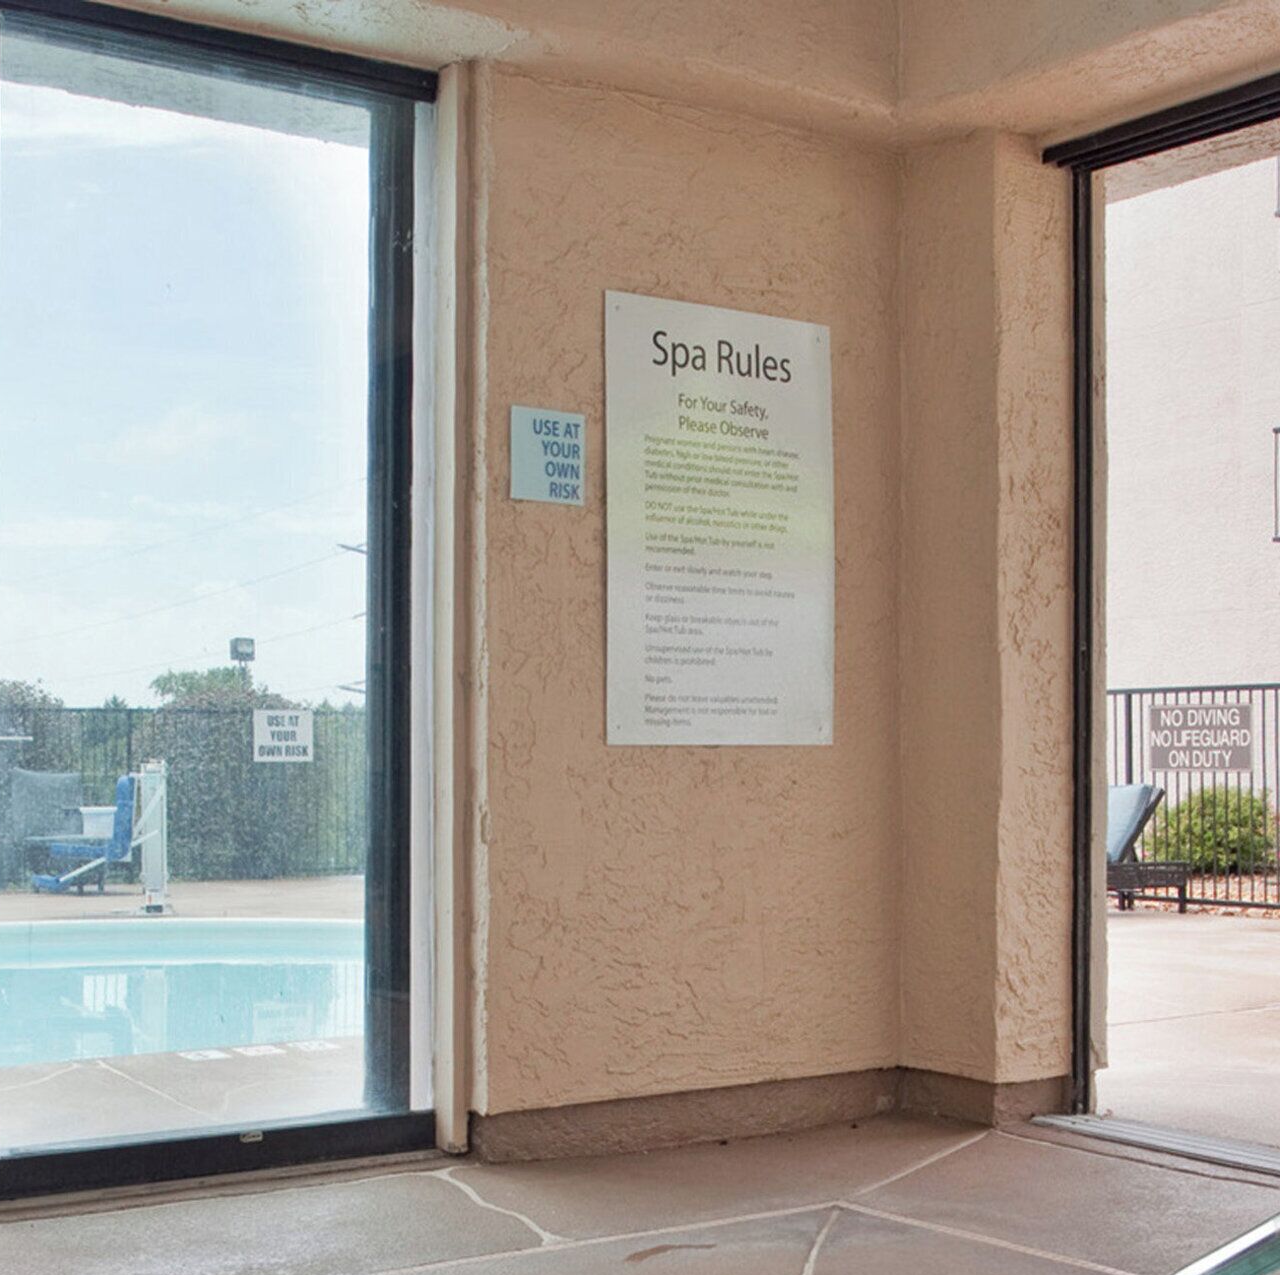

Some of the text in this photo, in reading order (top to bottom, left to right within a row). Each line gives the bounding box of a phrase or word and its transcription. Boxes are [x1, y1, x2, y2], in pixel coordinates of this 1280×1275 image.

[652, 331, 792, 383] Spa Rules
[678, 393, 769, 420] For Your Safety,
[533, 419, 579, 437] USE AT
[678, 415, 769, 440] Please Observe
[542, 441, 580, 460] YOUR
[545, 461, 580, 480] OWN
[549, 481, 579, 500] RISK
[267, 715, 299, 727] USE AT
[1160, 709, 1240, 726] NO DIVING
[270, 731, 297, 742] YOUR
[1151, 730, 1251, 747] NO LIFEGUARD
[258, 745, 308, 757] OWN RISK
[1169, 750, 1232, 767] ON DUTY
